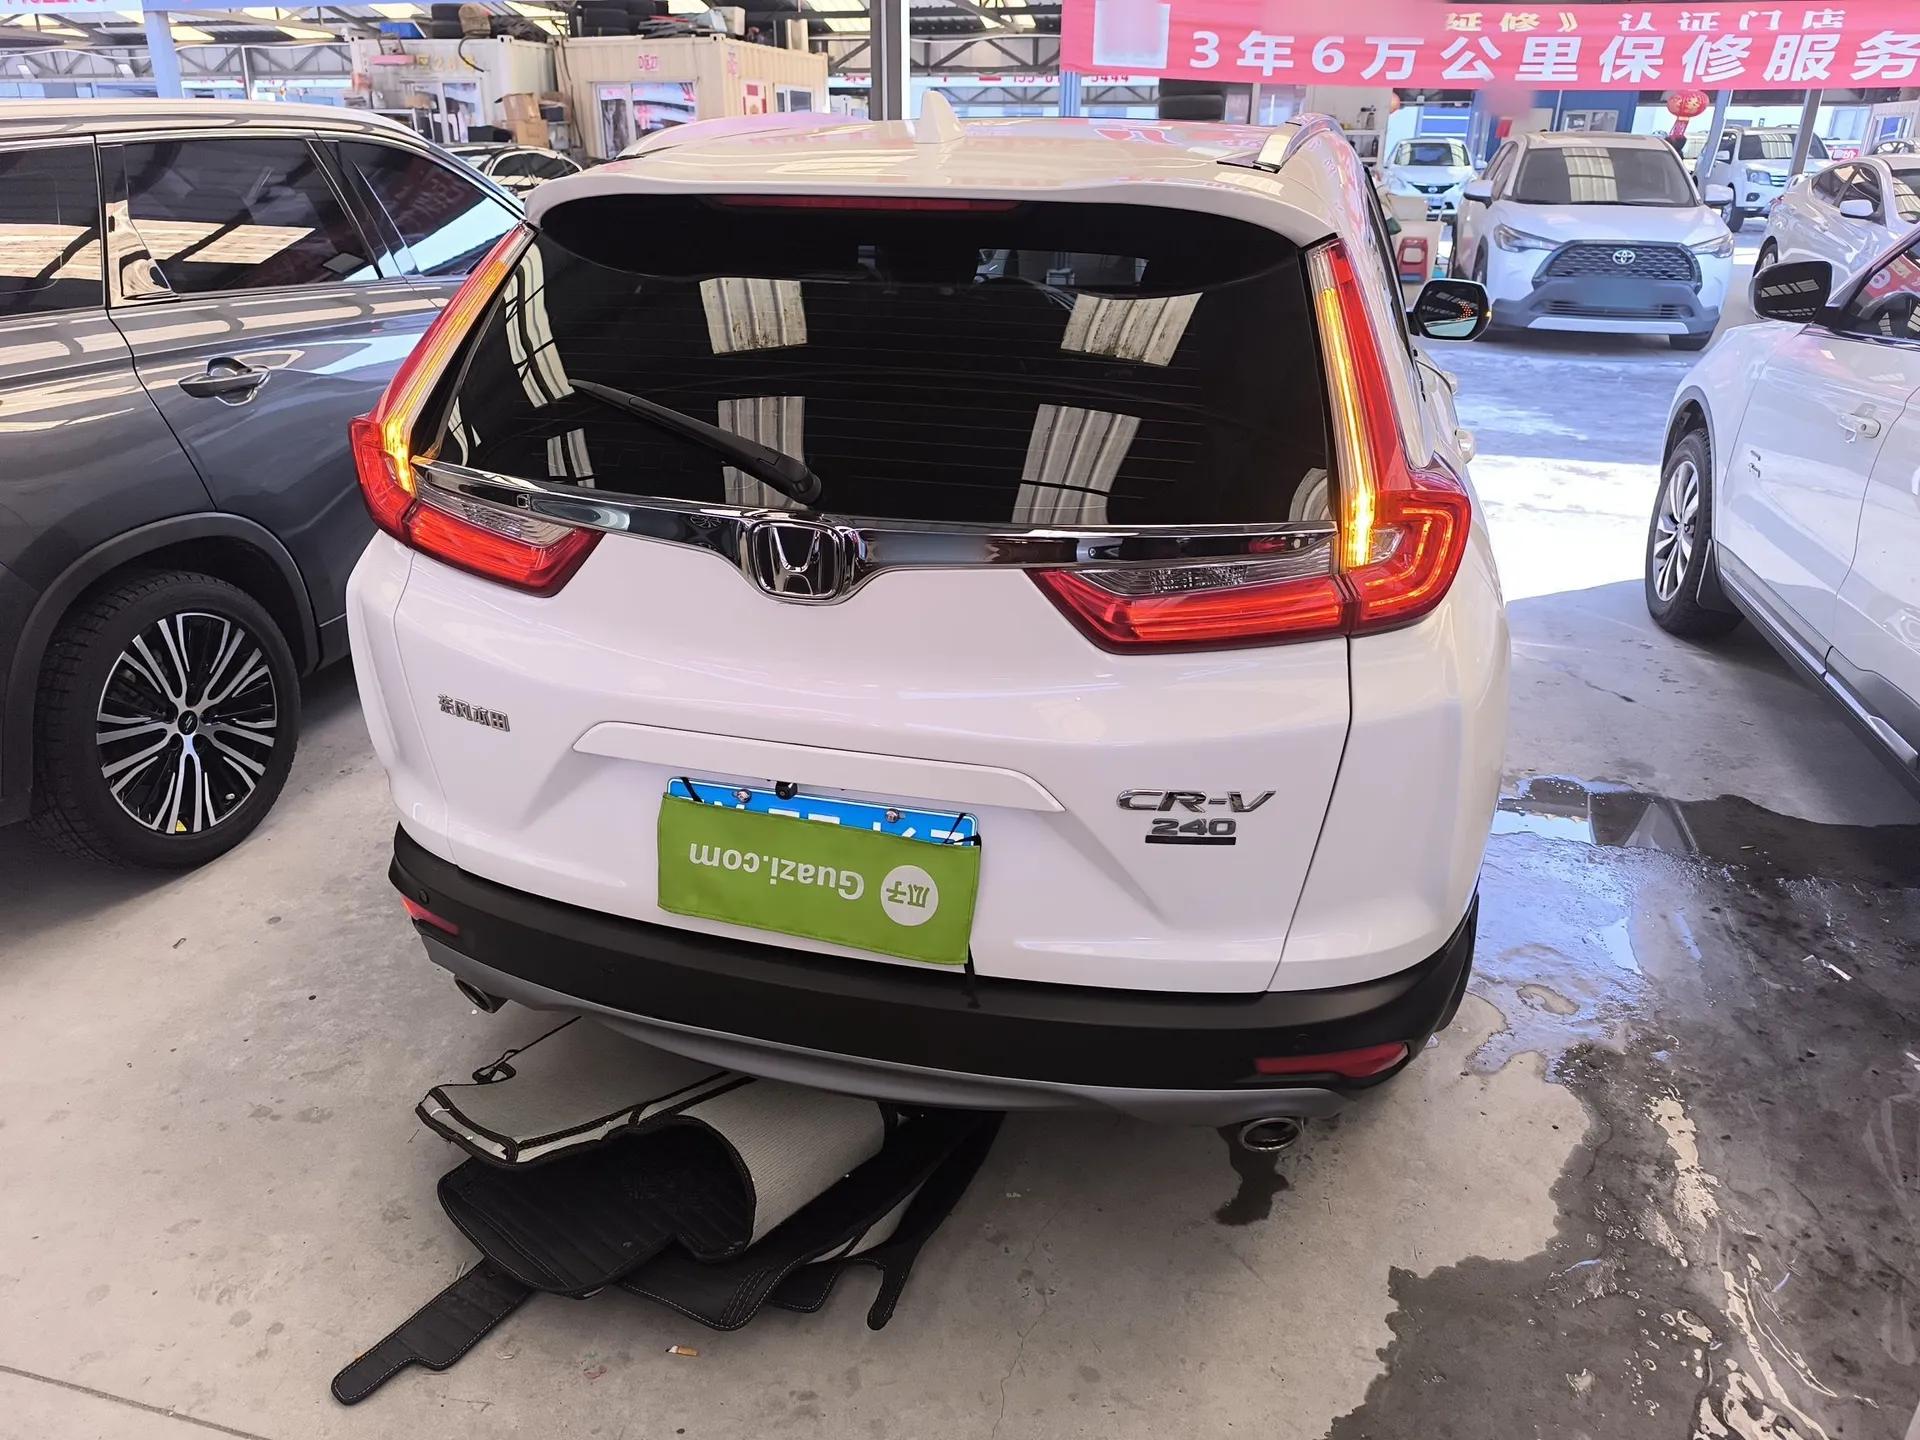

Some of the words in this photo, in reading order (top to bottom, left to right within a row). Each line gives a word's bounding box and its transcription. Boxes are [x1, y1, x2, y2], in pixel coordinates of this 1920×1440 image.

[1188, 29, 1919, 83] 3年6万公里保修服务
[438, 694, 511, 732] 东风本田
[1116, 789, 1277, 813] CR-V
[1151, 818, 1237, 835] 240
[688, 843, 865, 900] Guazi.com
[886, 881, 930, 908] 瓜子
